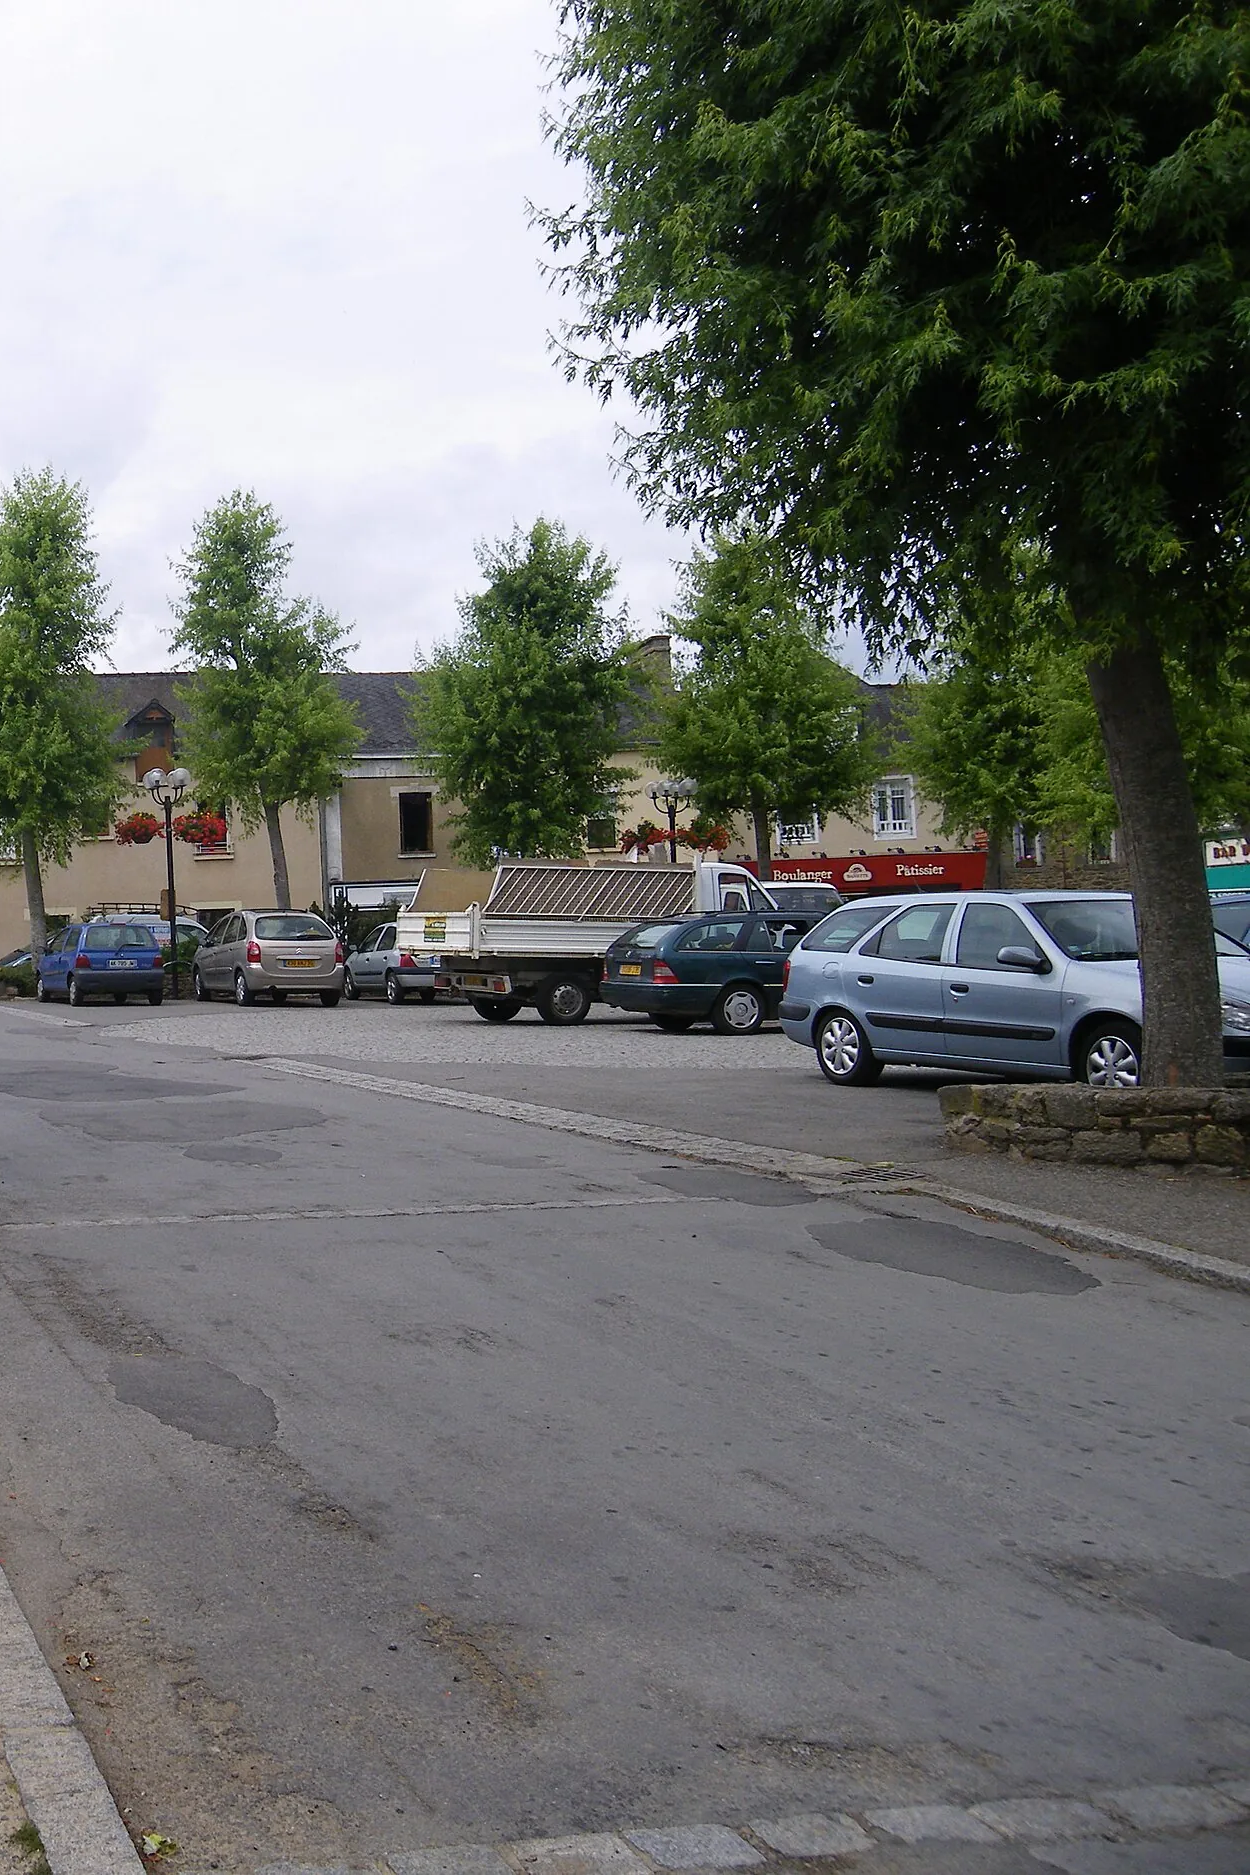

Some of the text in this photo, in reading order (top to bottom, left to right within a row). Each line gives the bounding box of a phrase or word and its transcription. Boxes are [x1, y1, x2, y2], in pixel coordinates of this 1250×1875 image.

[1213, 846, 1236, 859] BAR
[773, 869, 833, 883] Boulanger
[896, 864, 944, 876] Pâtissier
